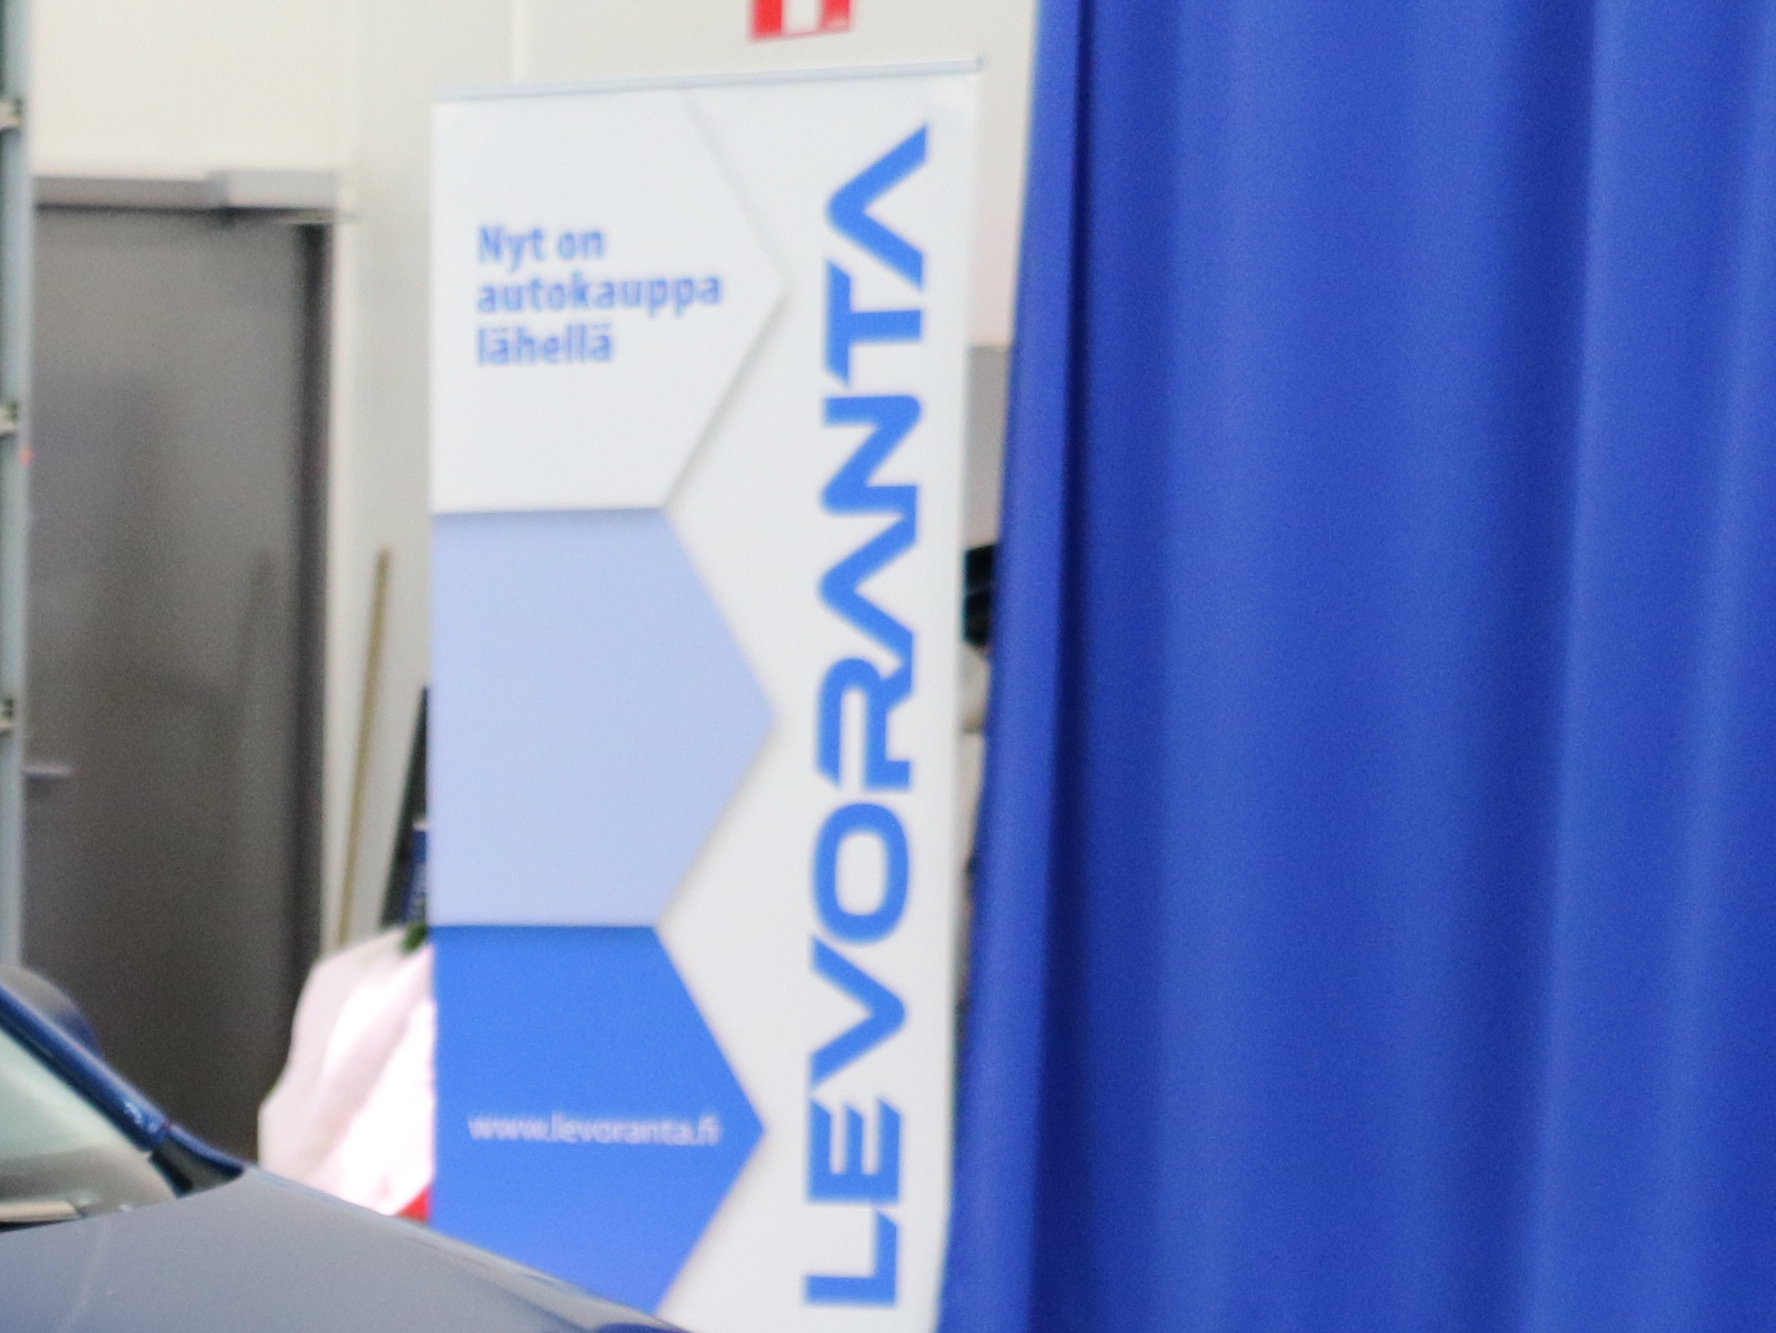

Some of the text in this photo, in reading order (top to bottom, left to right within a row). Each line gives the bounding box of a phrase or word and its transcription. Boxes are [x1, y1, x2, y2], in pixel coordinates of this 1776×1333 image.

[478, 226, 605, 272] Nyt on
[477, 271, 723, 317] autokauppa
[477, 323, 613, 365] lähellä
[802, 122, 930, 1307] LEVORANTA
[467, 1111, 722, 1146] www.levoranta.fi
